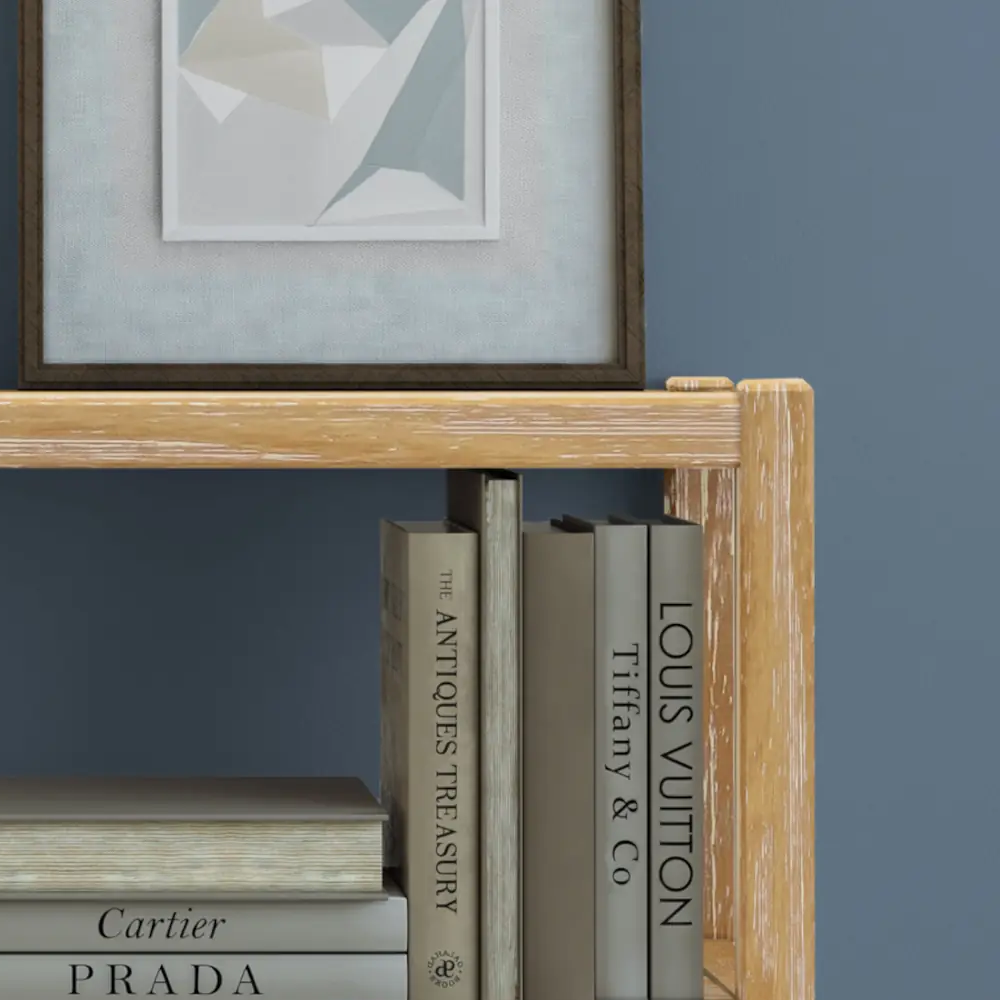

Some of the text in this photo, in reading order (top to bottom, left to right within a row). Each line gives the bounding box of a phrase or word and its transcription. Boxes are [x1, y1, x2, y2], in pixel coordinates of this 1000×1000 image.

[431, 569, 458, 914] THE ANTIQUES TREASURY
[604, 642, 641, 886] Tiffany & Co
[658, 602, 694, 927] LOUIS VUITTON
[67, 963, 264, 996] PRADA
[97, 906, 227, 940] Cartier
